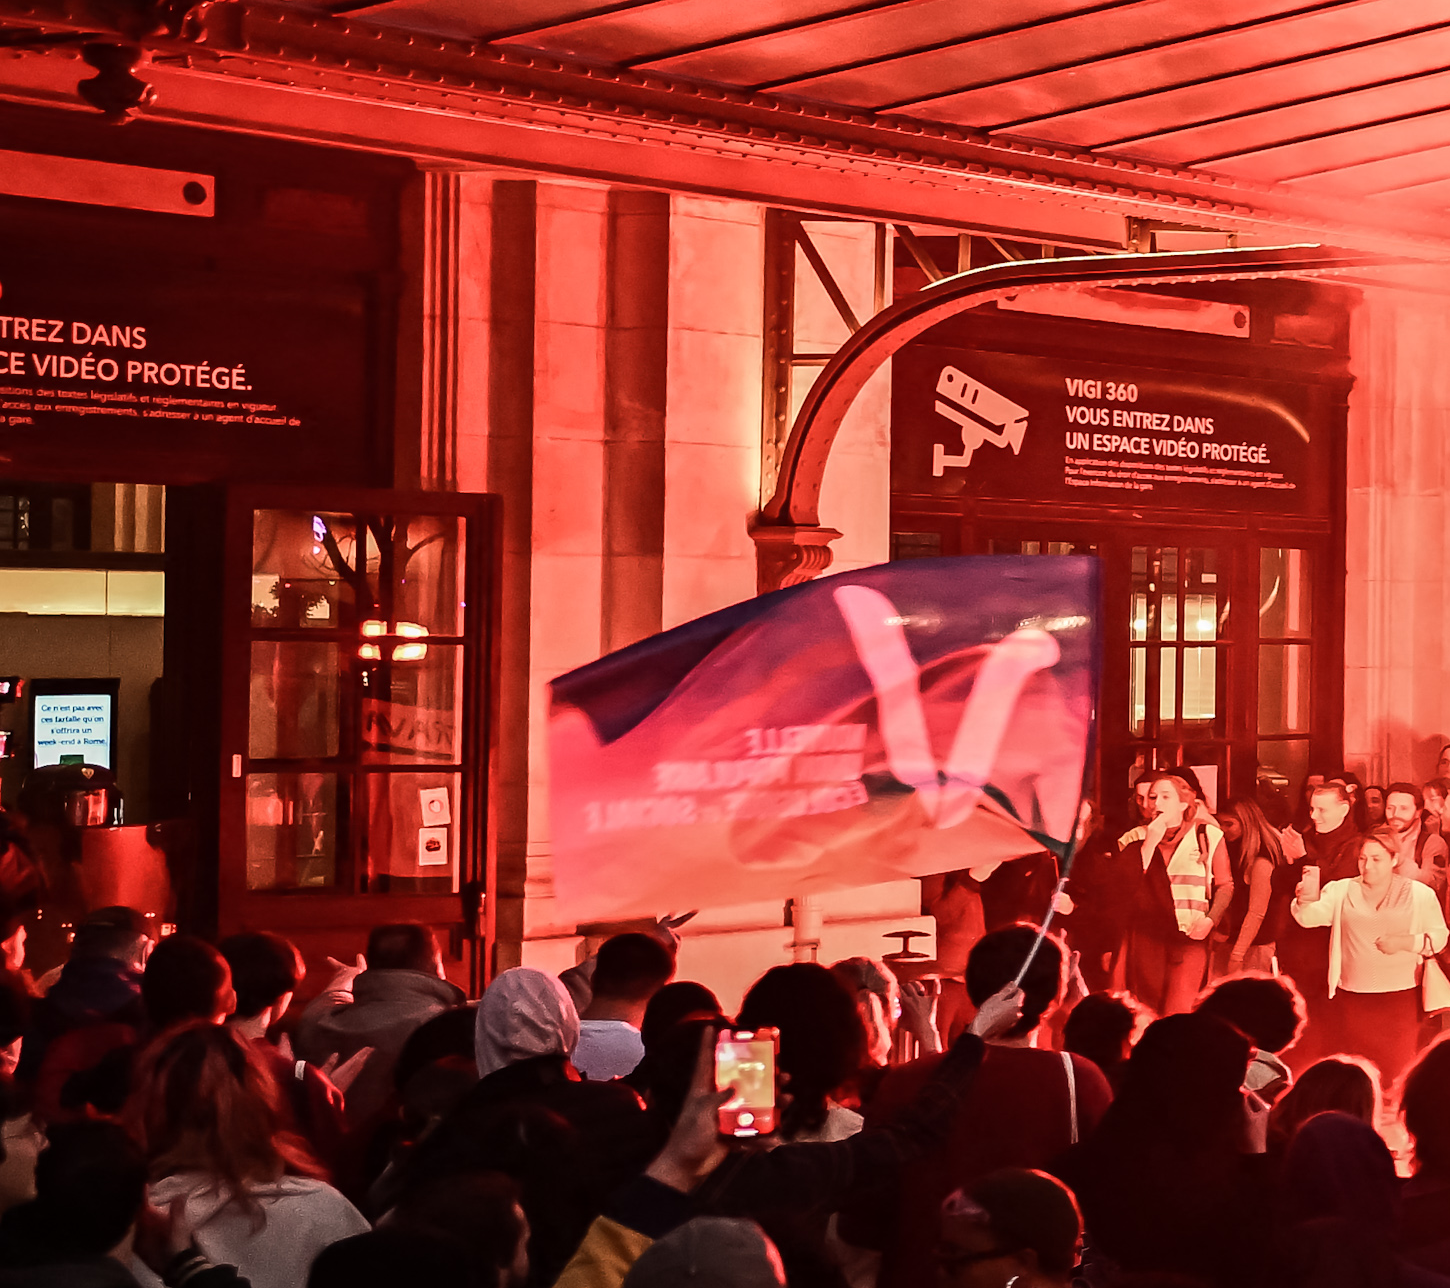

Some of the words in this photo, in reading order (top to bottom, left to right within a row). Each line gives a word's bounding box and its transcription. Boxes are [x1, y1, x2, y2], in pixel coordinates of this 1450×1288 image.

[72, 322, 147, 349] DANS
[32, 352, 119, 381] VIDÉO
[127, 361, 252, 390] PROTÉGÉ.
[1065, 378, 1101, 400] VIGI
[1106, 381, 1139, 403] 360
[1065, 405, 1109, 427] VOUS
[1113, 409, 1170, 432] ENTREZ
[1173, 415, 1214, 435] DANS
[1065, 431, 1090, 451] UN
[1093, 433, 1149, 456] ESPACE
[1152, 435, 1199, 459] VIDÉO
[1202, 441, 1271, 464] PROTÉGÉ.
